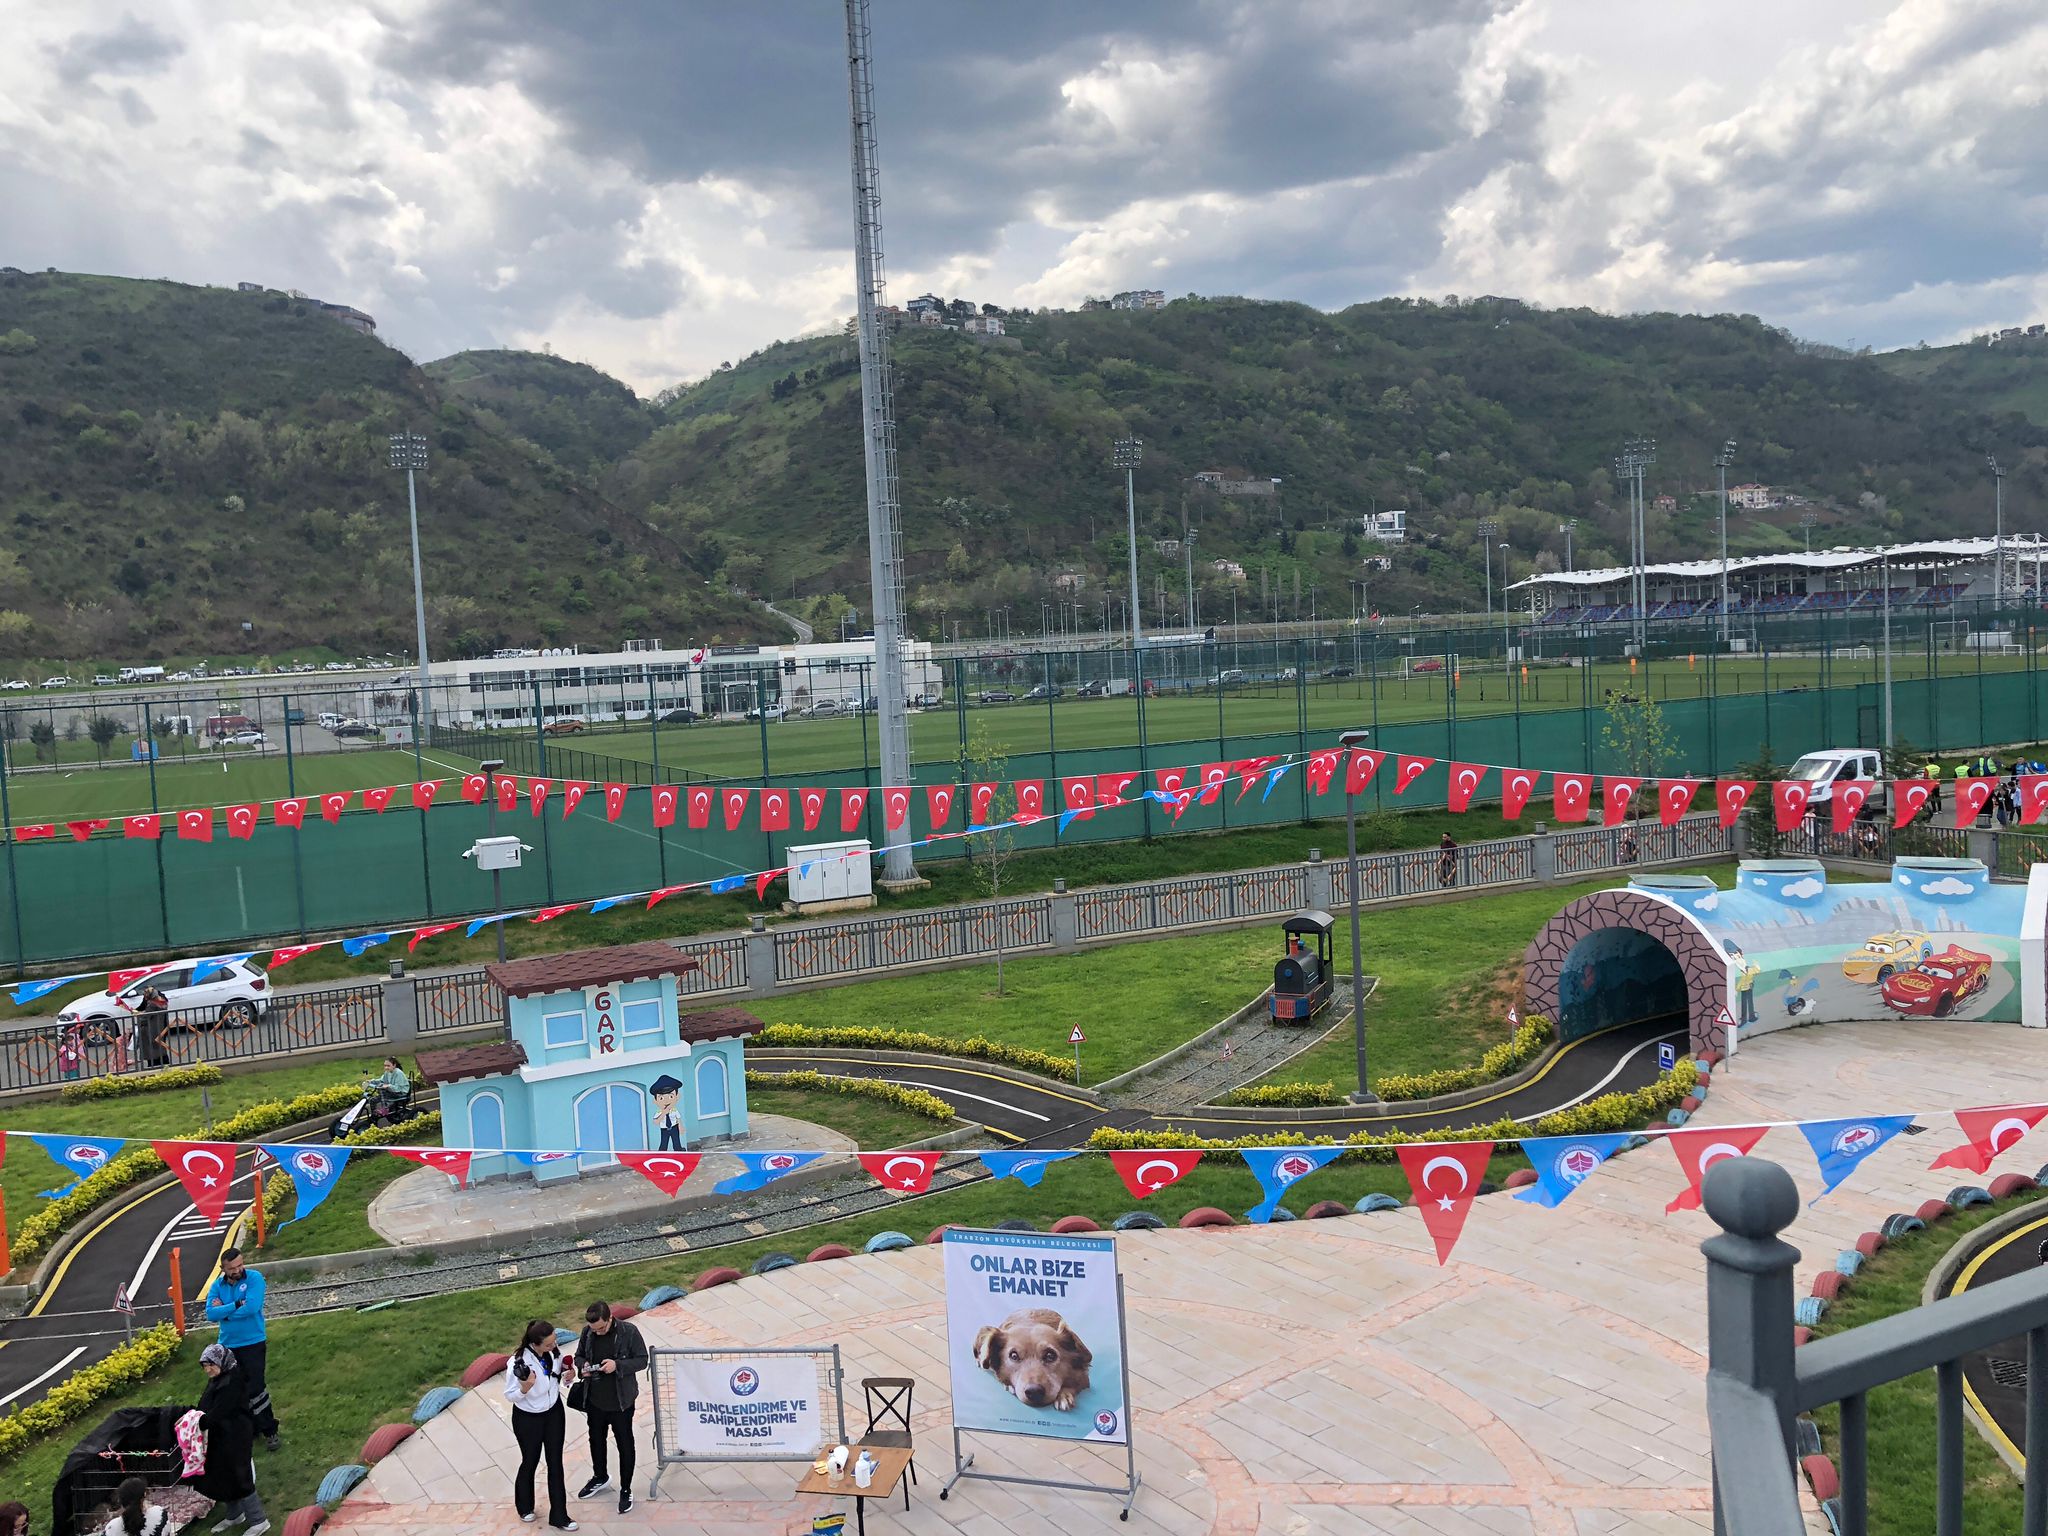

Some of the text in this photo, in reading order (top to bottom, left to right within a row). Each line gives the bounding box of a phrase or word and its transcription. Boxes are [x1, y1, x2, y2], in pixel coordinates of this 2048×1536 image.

[595, 992, 616, 1054] GAR
[953, 1234, 990, 1242] TRABZON
[970, 1254, 1086, 1279] ONLAR BİZE
[989, 1275, 1068, 1297] EMANET
[790, 1400, 807, 1411] VE
[700, 1413, 797, 1427] SAHİPLENDİRME
[725, 1426, 772, 1438] MASASI
